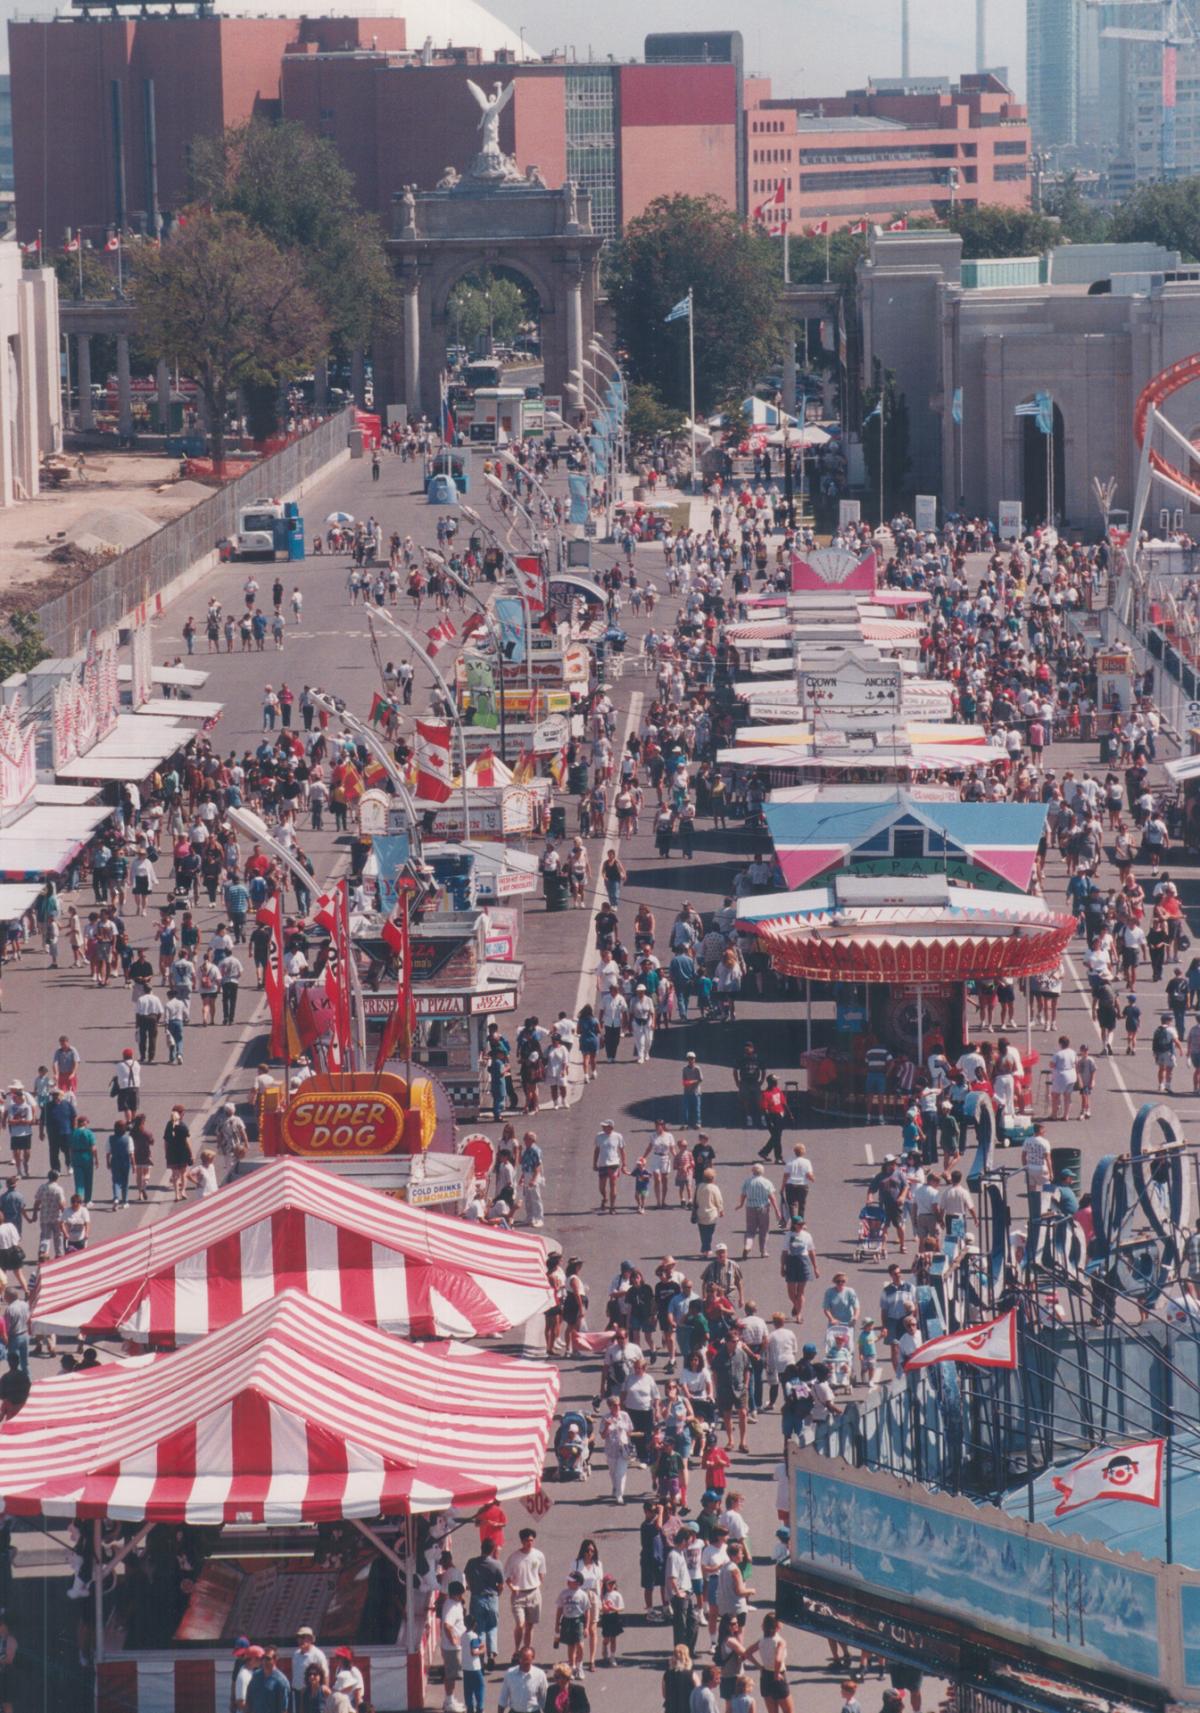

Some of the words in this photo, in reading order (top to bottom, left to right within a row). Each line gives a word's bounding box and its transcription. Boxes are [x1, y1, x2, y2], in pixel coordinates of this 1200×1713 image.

[805, 677, 837, 687] CROWN
[864, 677, 898, 687] ANCHOR
[891, 860, 1005, 891] PALACE
[481, 993, 504, 1003] HOT
[363, 998, 397, 1014] FRESH
[428, 997, 460, 1013] PIZZA
[476, 1001, 510, 1011] PIZZA
[293, 1103, 386, 1126] SUPER
[310, 1126, 376, 1147] DOG
[411, 1190, 461, 1204] LEMONADE
[412, 1187, 431, 1197] COLD
[433, 1183, 462, 1194] DRINKS
